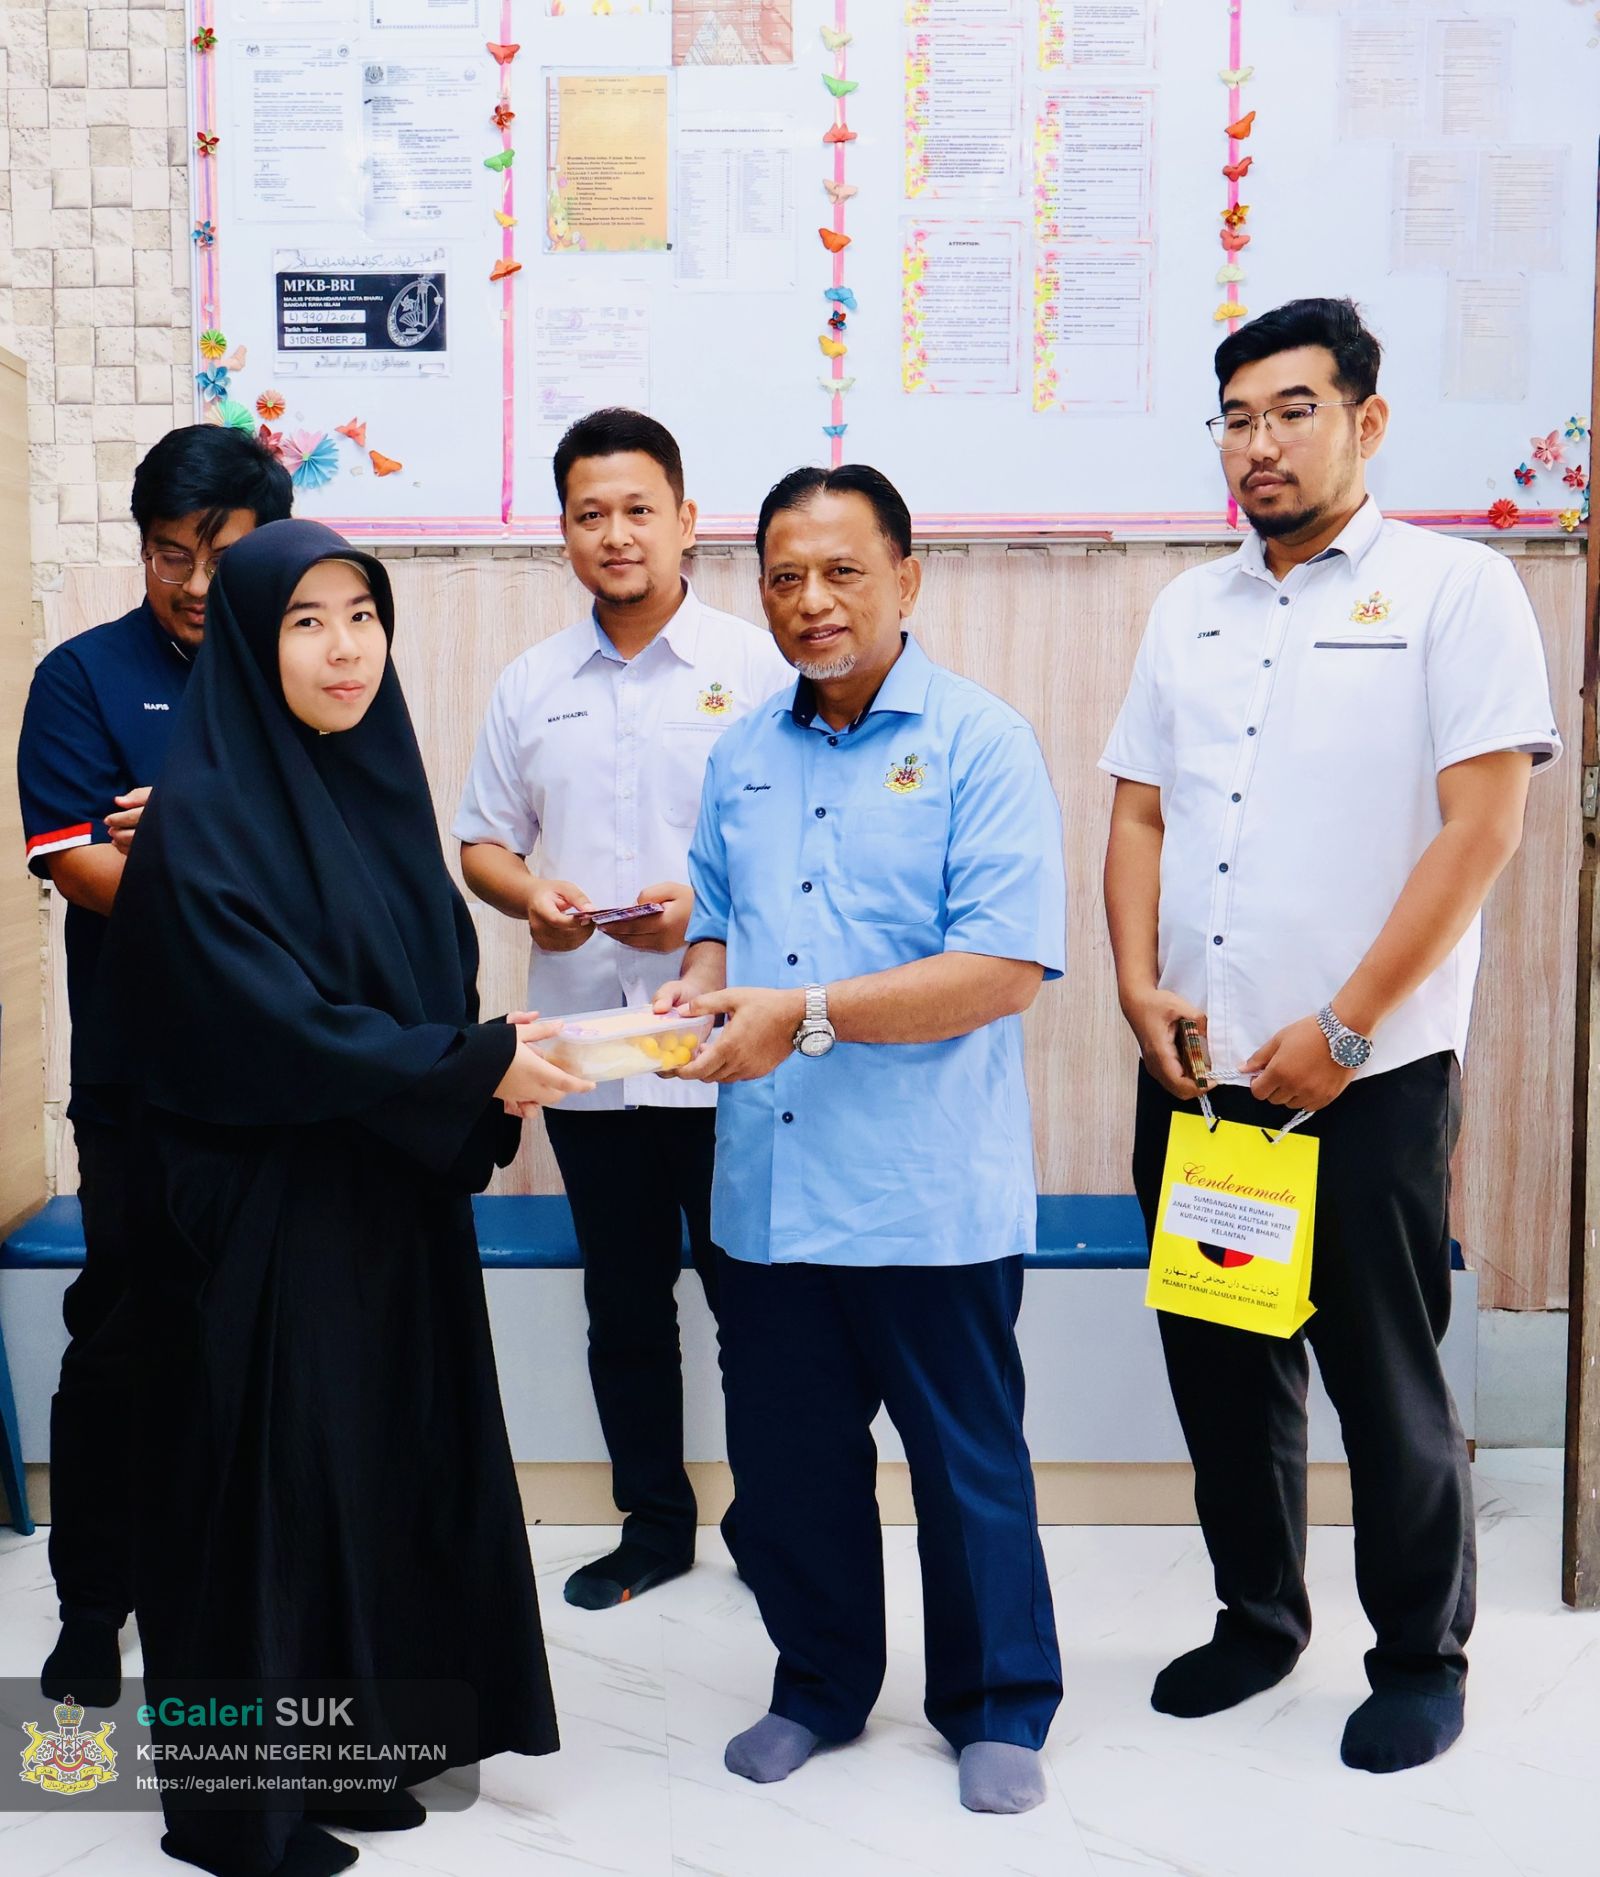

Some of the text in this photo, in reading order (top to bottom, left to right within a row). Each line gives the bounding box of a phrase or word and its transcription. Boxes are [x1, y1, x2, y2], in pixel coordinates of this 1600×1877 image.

[284, 279, 355, 292] MPKB-BRI
[1183, 1162, 1296, 1204] Cenderamata
[1172, 1201, 1192, 1209] ANAK
[1193, 1205, 1213, 1214] YATIM
[1215, 1209, 1237, 1220] DARUL
[1238, 1215, 1269, 1226] KAUTSAR
[1194, 1195, 1238, 1210] SUMBANGAN
[1248, 1207, 1274, 1218] RUMAH
[1211, 1228, 1246, 1241] KELANTAN
[1237, 1224, 1254, 1233] KOTA
[1162, 1278, 1187, 1289] PEJABAT
[1188, 1285, 1208, 1295] TANAH
[1237, 1295, 1255, 1305] KOTA
[1256, 1300, 1278, 1309] BHARU
